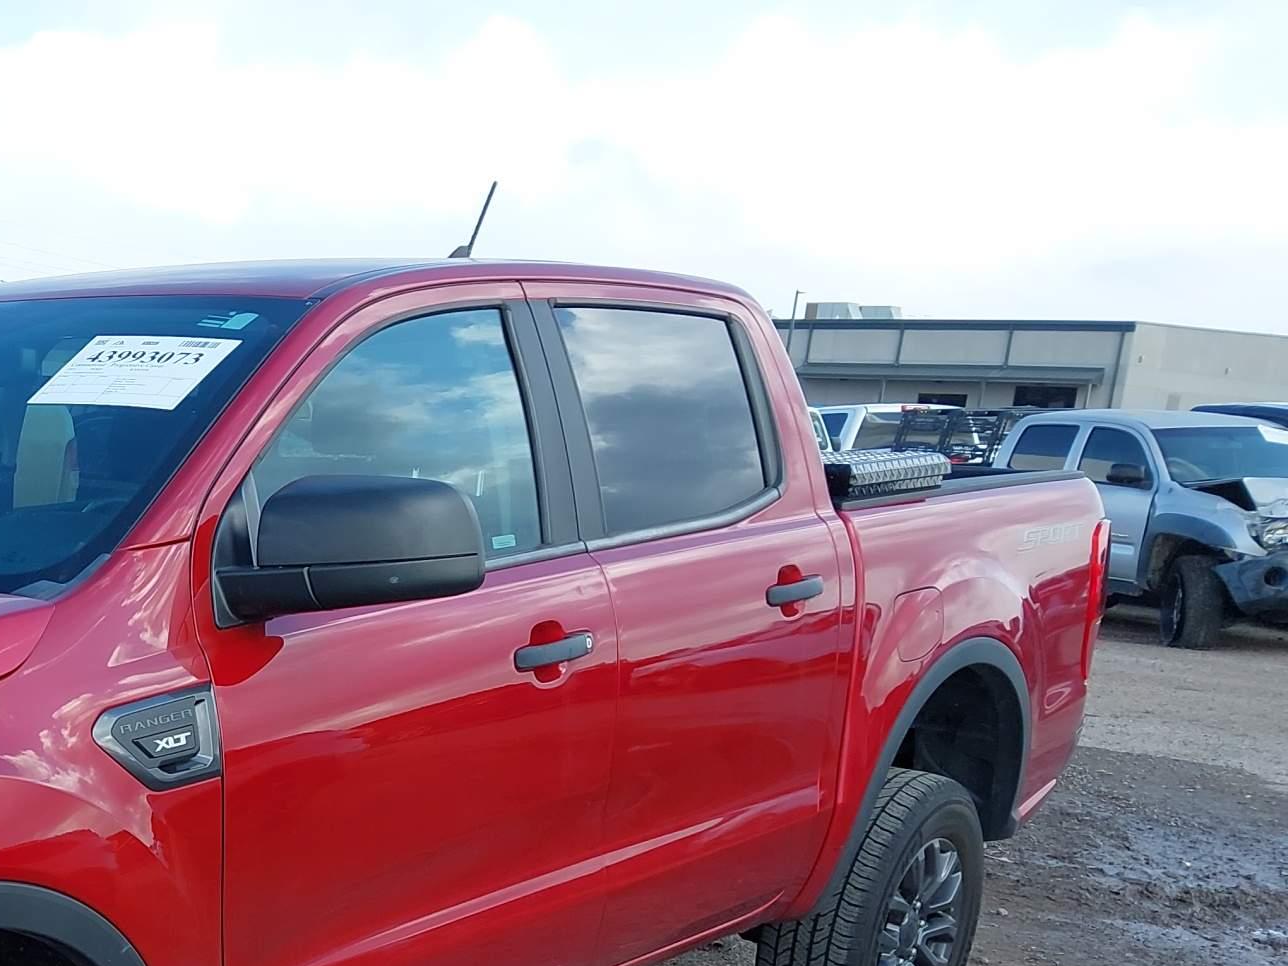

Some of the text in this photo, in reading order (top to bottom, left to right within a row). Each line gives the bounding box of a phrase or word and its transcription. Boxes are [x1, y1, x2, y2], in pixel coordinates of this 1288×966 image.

[86, 349, 204, 366] 43993073
[1016, 522, 1086, 552] SPORT
[119, 708, 193, 735] RANGER
[153, 731, 192, 753] XLT
